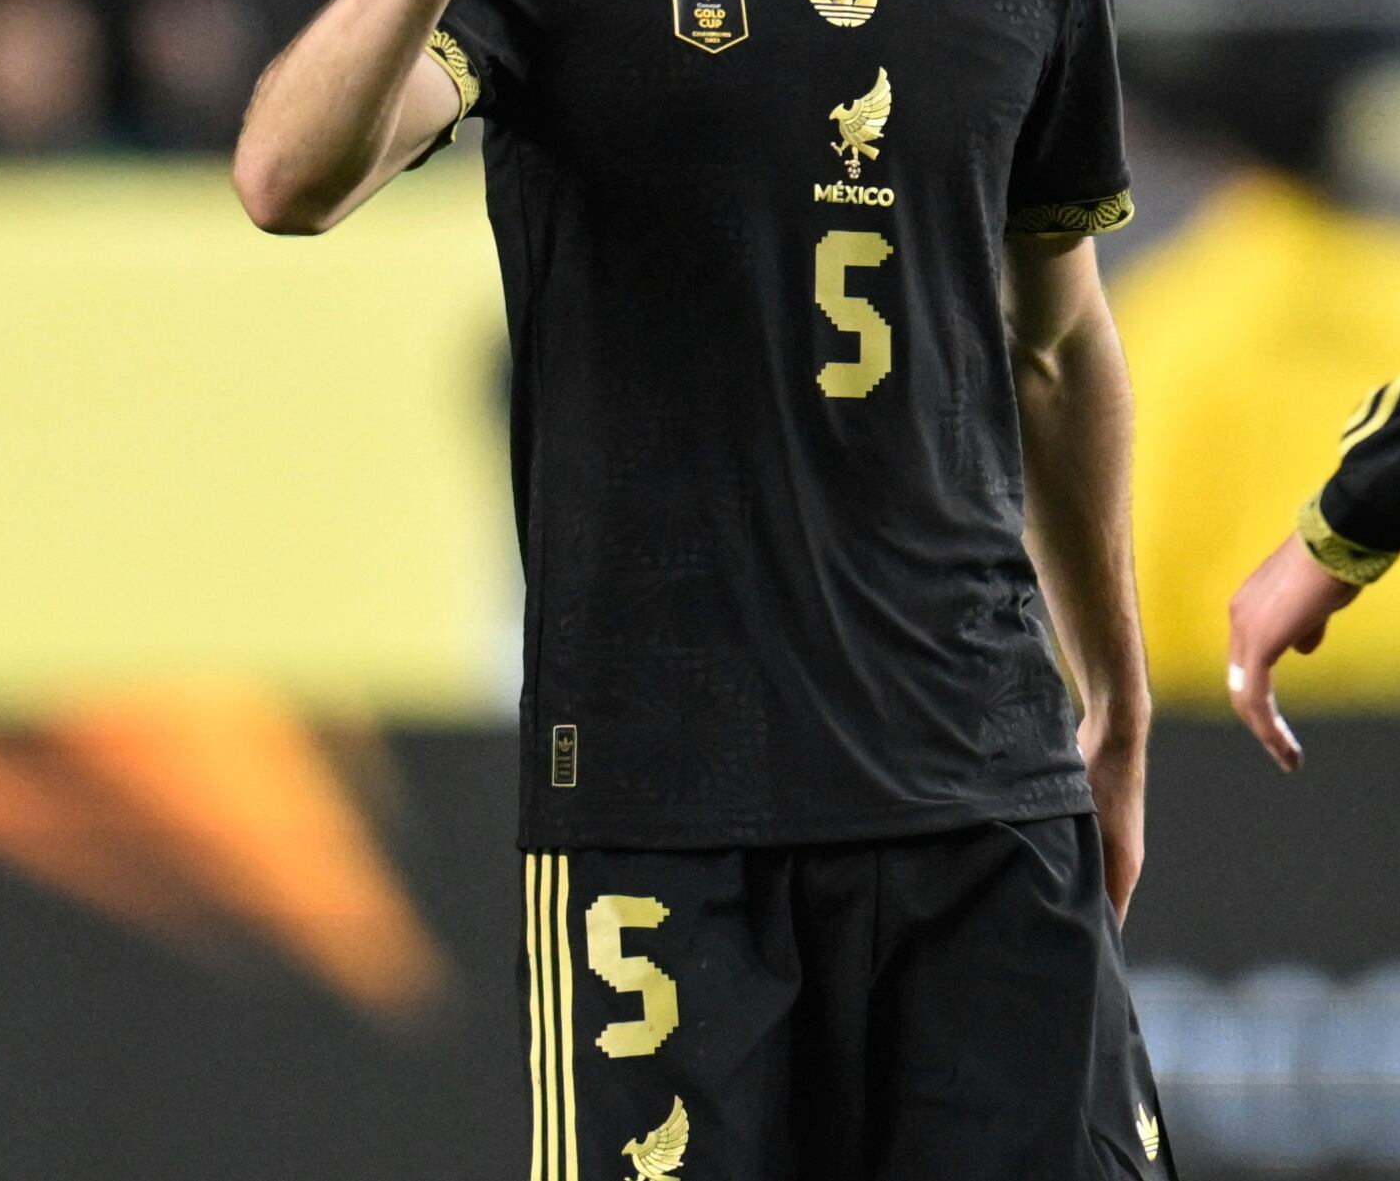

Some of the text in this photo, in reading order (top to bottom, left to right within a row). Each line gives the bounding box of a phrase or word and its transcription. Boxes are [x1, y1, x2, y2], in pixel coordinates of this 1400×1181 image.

[694, 8, 726, 19] GOLD
[699, 18, 722, 28] CUP
[814, 180, 895, 207] MÉXICO
[814, 230, 893, 398] 5
[585, 894, 679, 1059] 5
